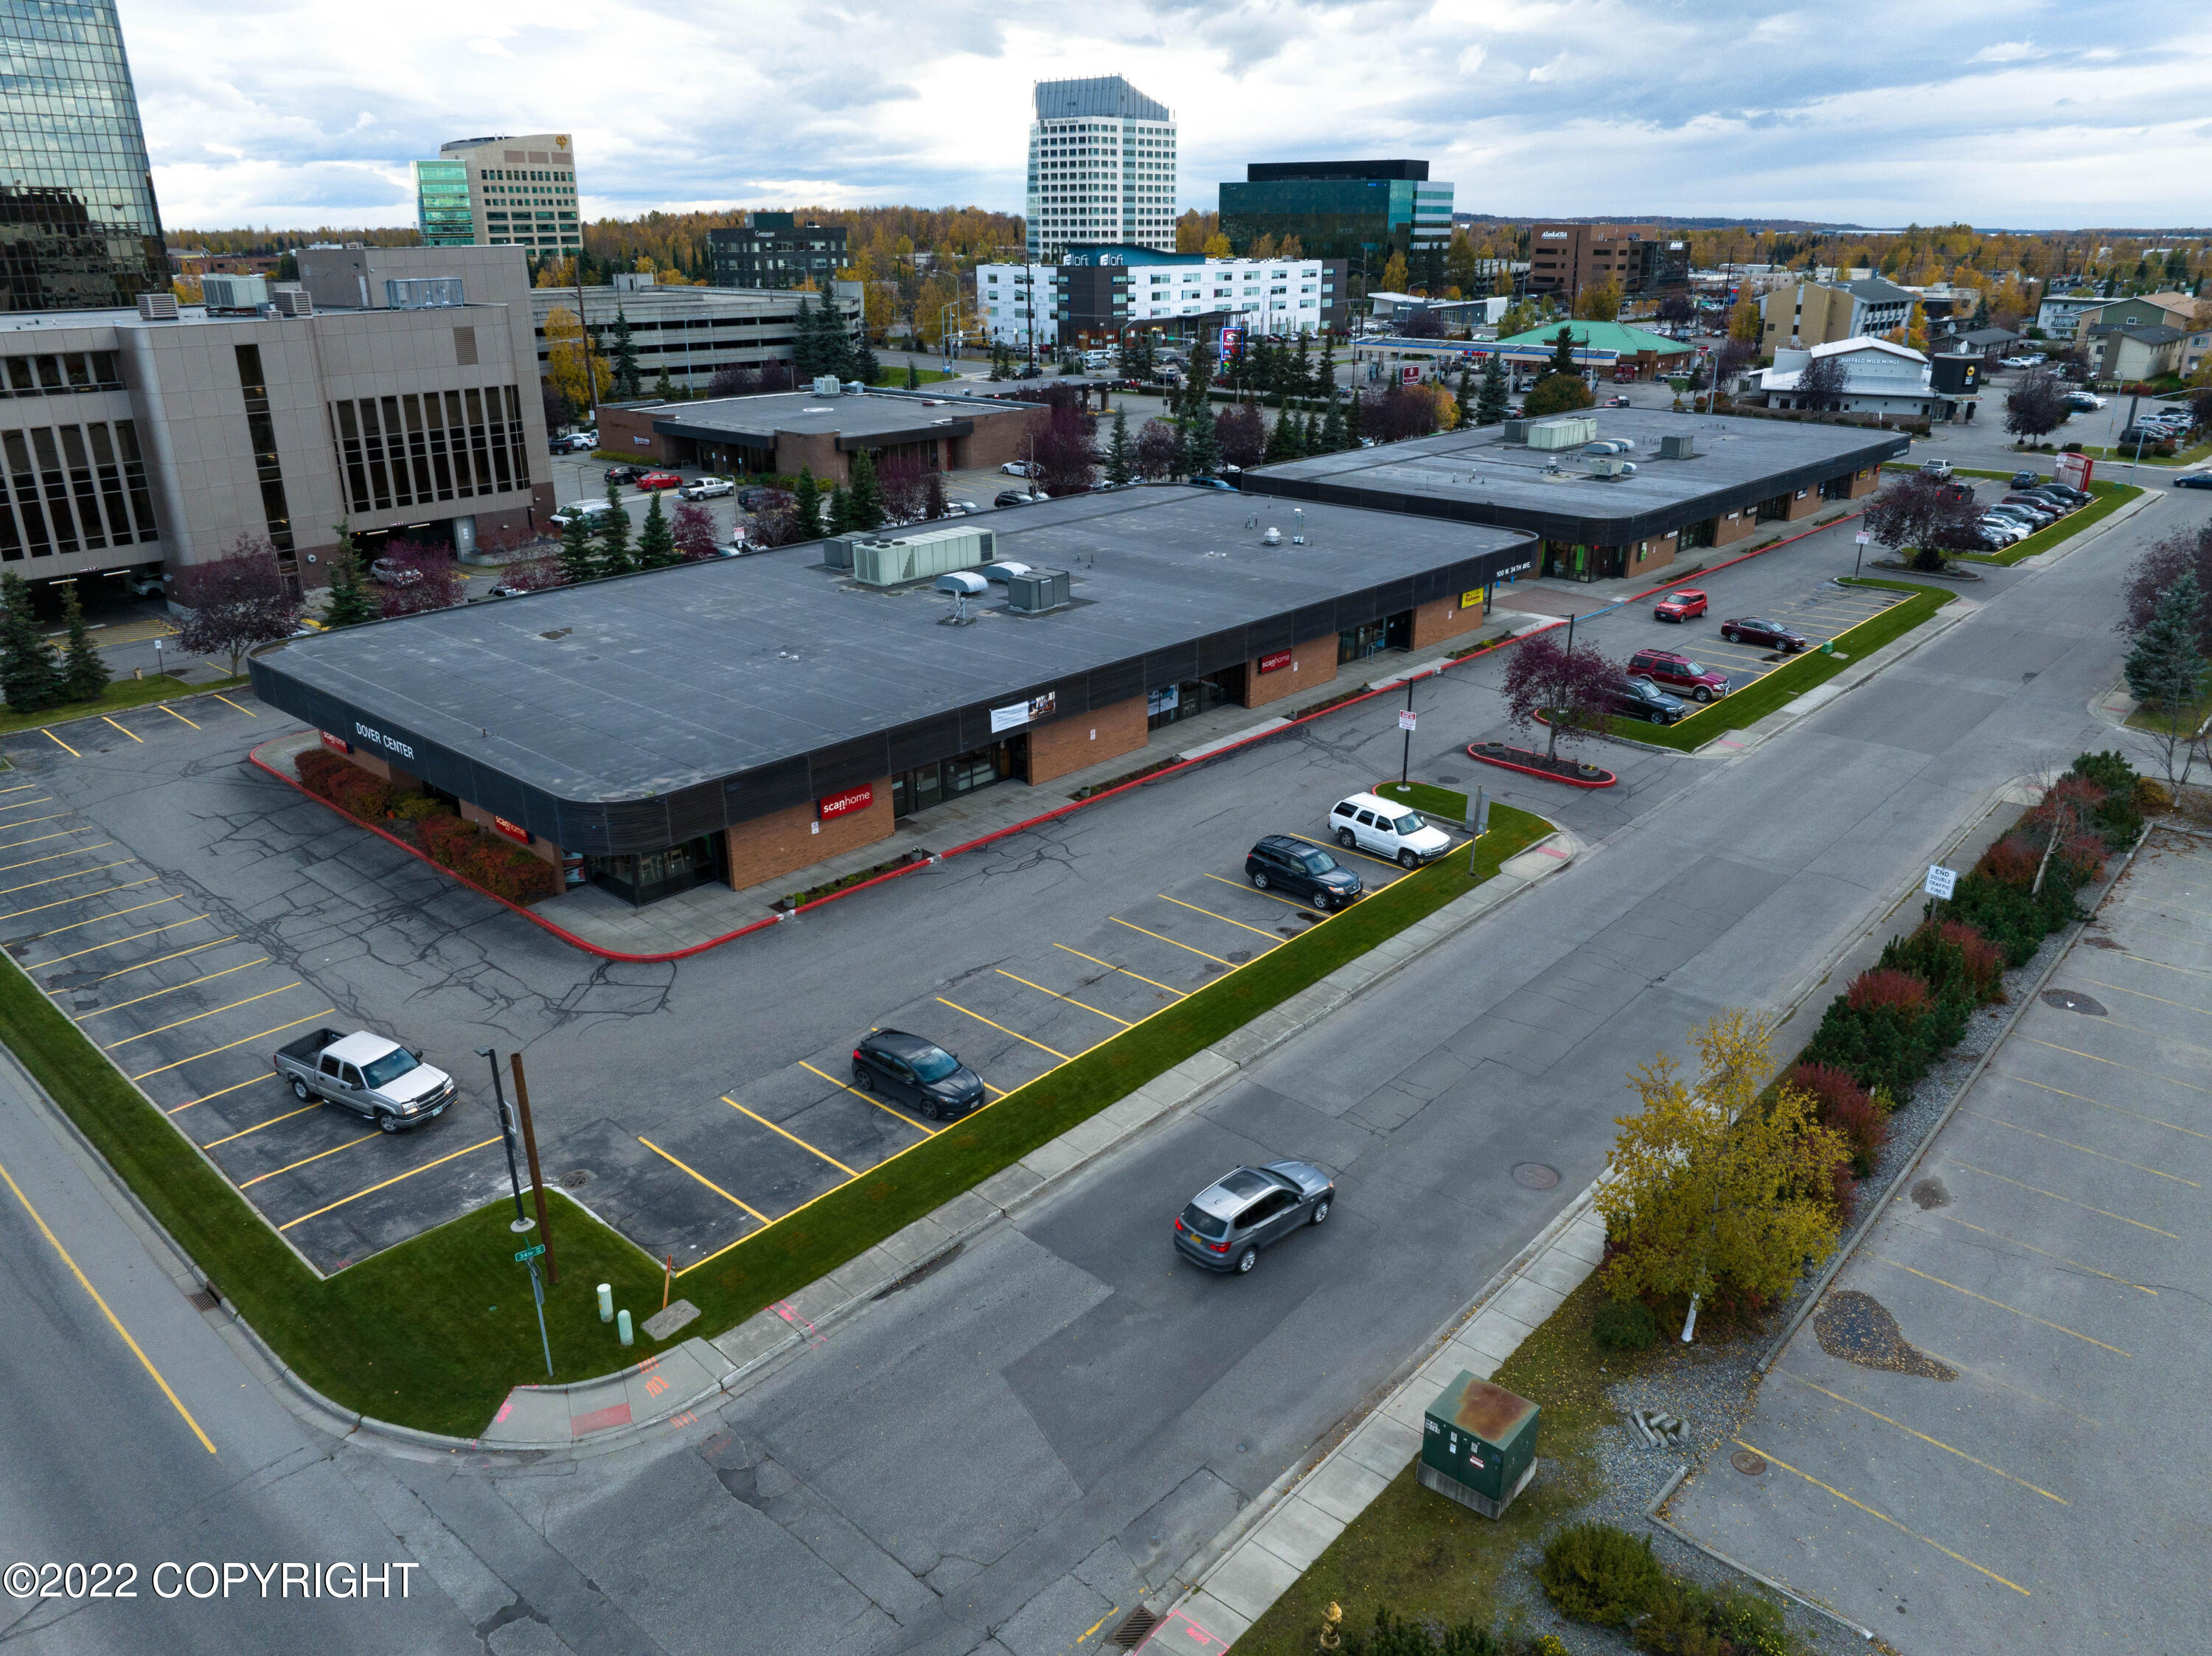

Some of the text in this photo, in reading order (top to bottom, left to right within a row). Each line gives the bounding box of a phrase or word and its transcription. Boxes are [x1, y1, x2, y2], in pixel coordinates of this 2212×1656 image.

[1463, 349, 1488, 358] Holiday
[1262, 654, 1291, 668] scanhome
[356, 722, 415, 760] DOVER CENTER
[824, 791, 871, 813] scanhome
[1929, 880, 1951, 891] TRAFFIC
[1930, 874, 1952, 885] DOUBLE
